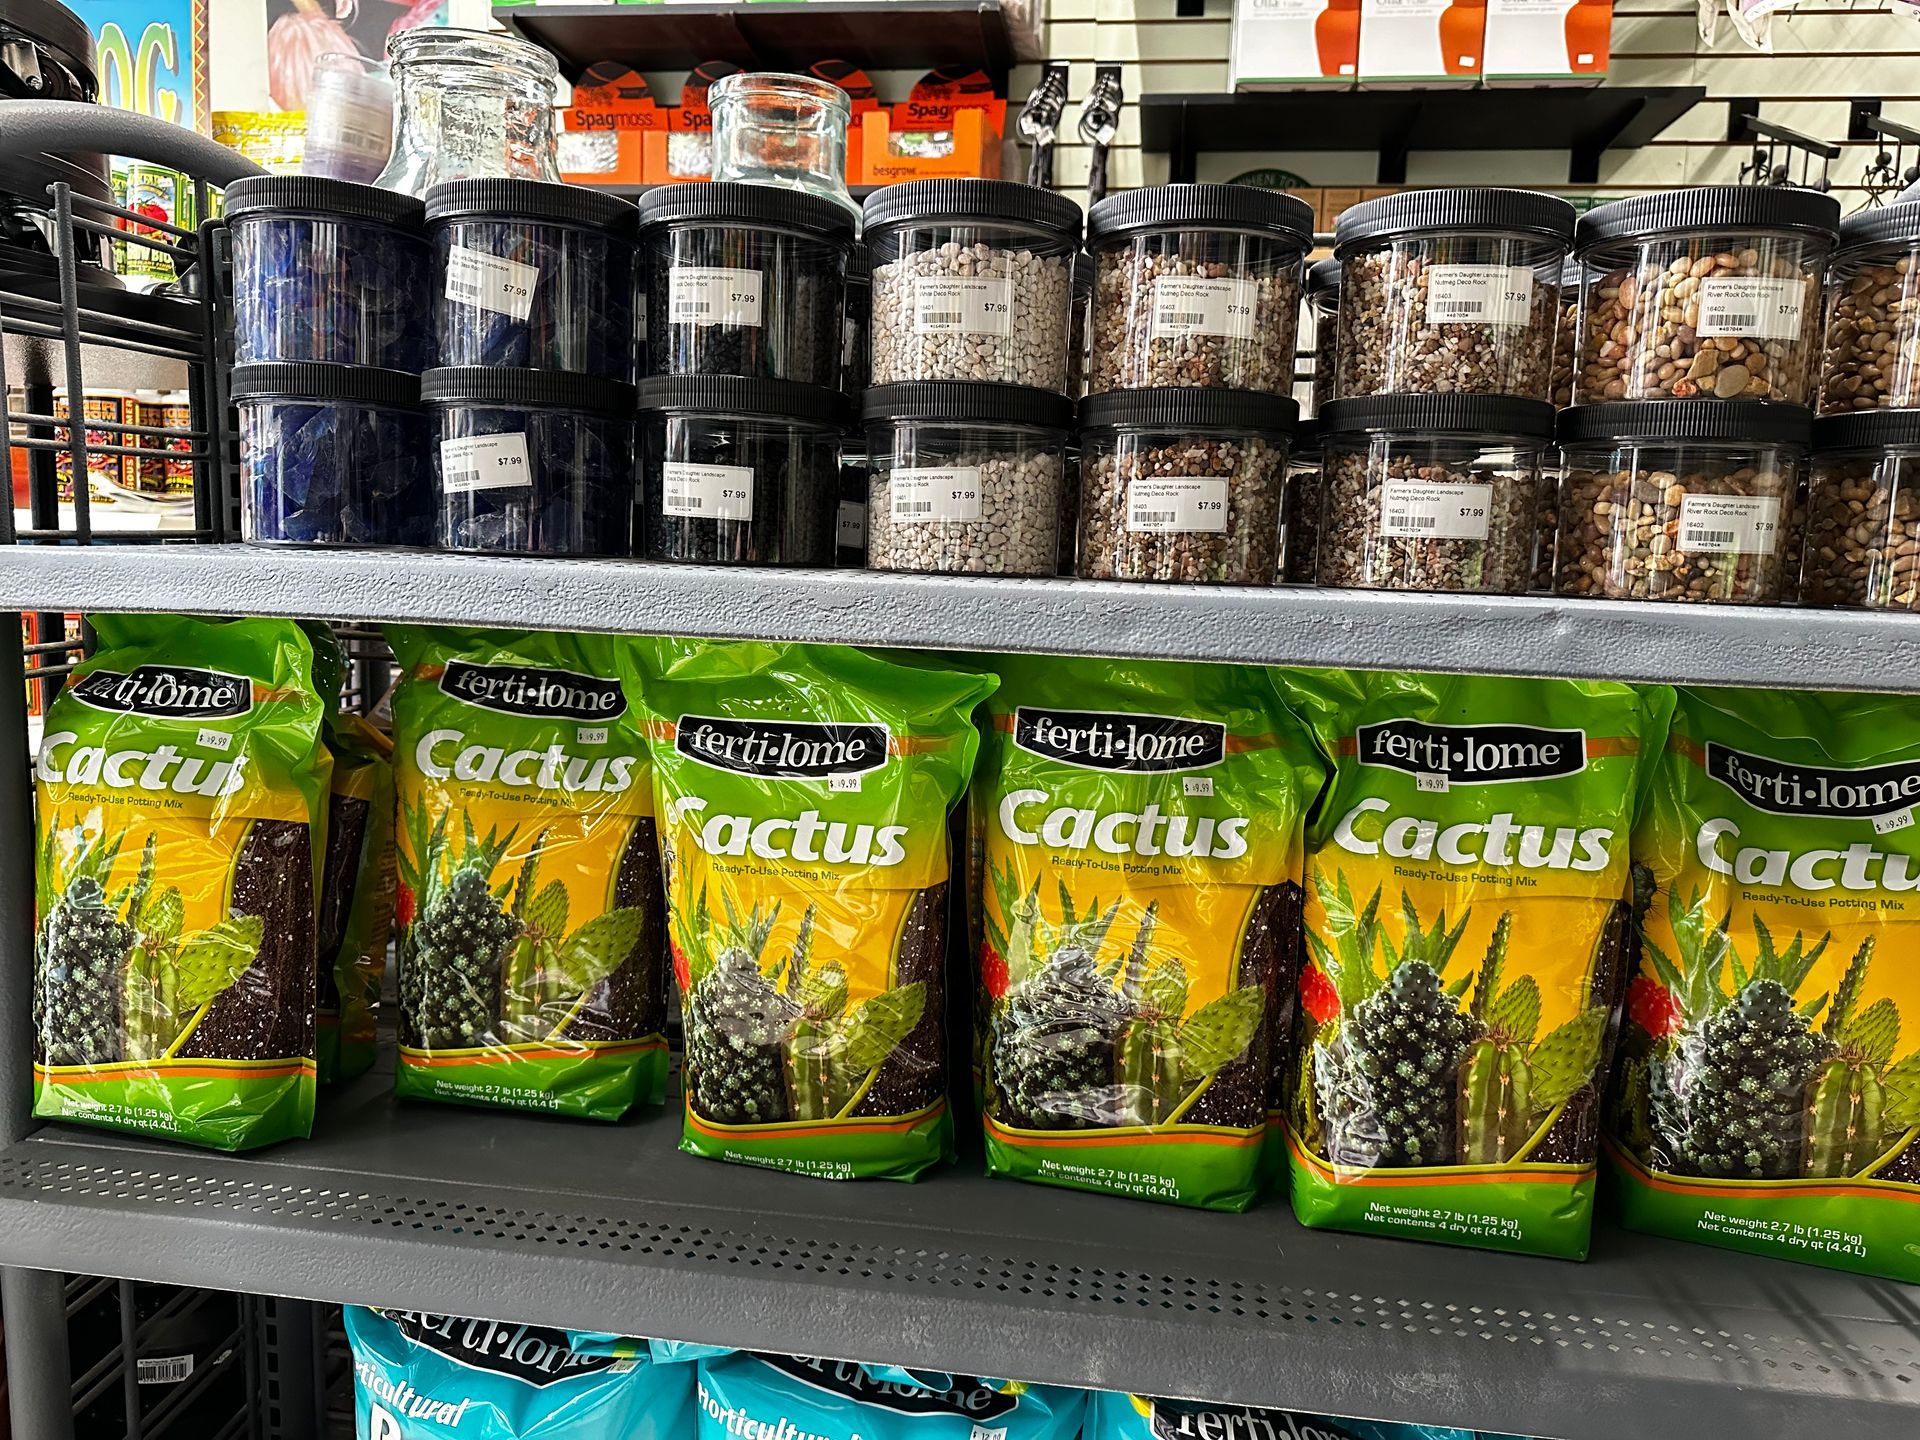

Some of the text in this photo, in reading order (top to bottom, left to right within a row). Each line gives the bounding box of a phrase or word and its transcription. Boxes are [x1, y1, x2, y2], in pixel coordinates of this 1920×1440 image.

[576, 110, 652, 129] Spagmoss
[873, 166, 916, 178] besgrow
[503, 284, 526, 296] $7.99
[731, 294, 755, 303] $7.99
[1505, 292, 1526, 301] $7.99
[985, 303, 1007, 312] $7.99
[1227, 305, 1249, 315] $7.99
[498, 457, 521, 465] $7.99
[723, 490, 746, 499] $7.99
[952, 491, 974, 500] $7.99
[1198, 502, 1221, 510] $7.99
[1460, 508, 1483, 516] $7.99
[1755, 522, 1773, 531] $7.99
[415, 729, 637, 792] Cactus
[68, 792, 183, 809] Ready-To-Use Potting Mix
[523, 794, 557, 806] Potting
[675, 796, 909, 866] Cactus
[999, 789, 1250, 859] Cactus
[1333, 797, 1614, 871] Cactus
[1697, 818, 1920, 892] Cactu
[712, 863, 839, 881] Ready-To-Use Potting Mix
[1051, 856, 1182, 874] Ready-To-Use Potting Mix
[1394, 866, 1537, 887] Ready-To-Use Potting Mix
[1742, 892, 1904, 910] Ready-To-Use Potting Mix
[437, 1080, 452, 1089] Net
[455, 1084, 483, 1093] weight
[485, 1086, 500, 1094] 2.7
[513, 1088, 537, 1098] (1.25
[540, 1090, 553, 1099] kg)
[64, 1097, 173, 1121] Net weight 2.7 lb (1.25 kg)
[725, 1150, 850, 1172] Net weight 2.7 lb (1.25 kg)
[1042, 1160, 1175, 1188] Net weight 2.7 lb (1.25 kg)
[1038, 1169, 1056, 1177] Net
[1059, 1173, 1101, 1185] contents
[1115, 1182, 1130, 1192] dry
[1133, 1185, 1143, 1194] qt
[1146, 1185, 1166, 1196] (4.4
[1170, 1188, 1179, 1199] L)
[1370, 1202, 1518, 1229] Net weight 2.7 lb (1.25 kg)
[1365, 1212, 1385, 1222] Net
[1387, 1217, 1435, 1228] contents
[1450, 1222, 1467, 1234] dry
[1470, 1226, 1482, 1234] qt
[1485, 1227, 1507, 1236] (4.4
[1511, 1230, 1522, 1240] L)
[1704, 1210, 1862, 1245] Net weight 2.7 lb (1.25 kg)
[1697, 1220, 1866, 1257] Net contents 4 dry qt (4.4 L)
[355, 1360, 470, 1428] rticultural
